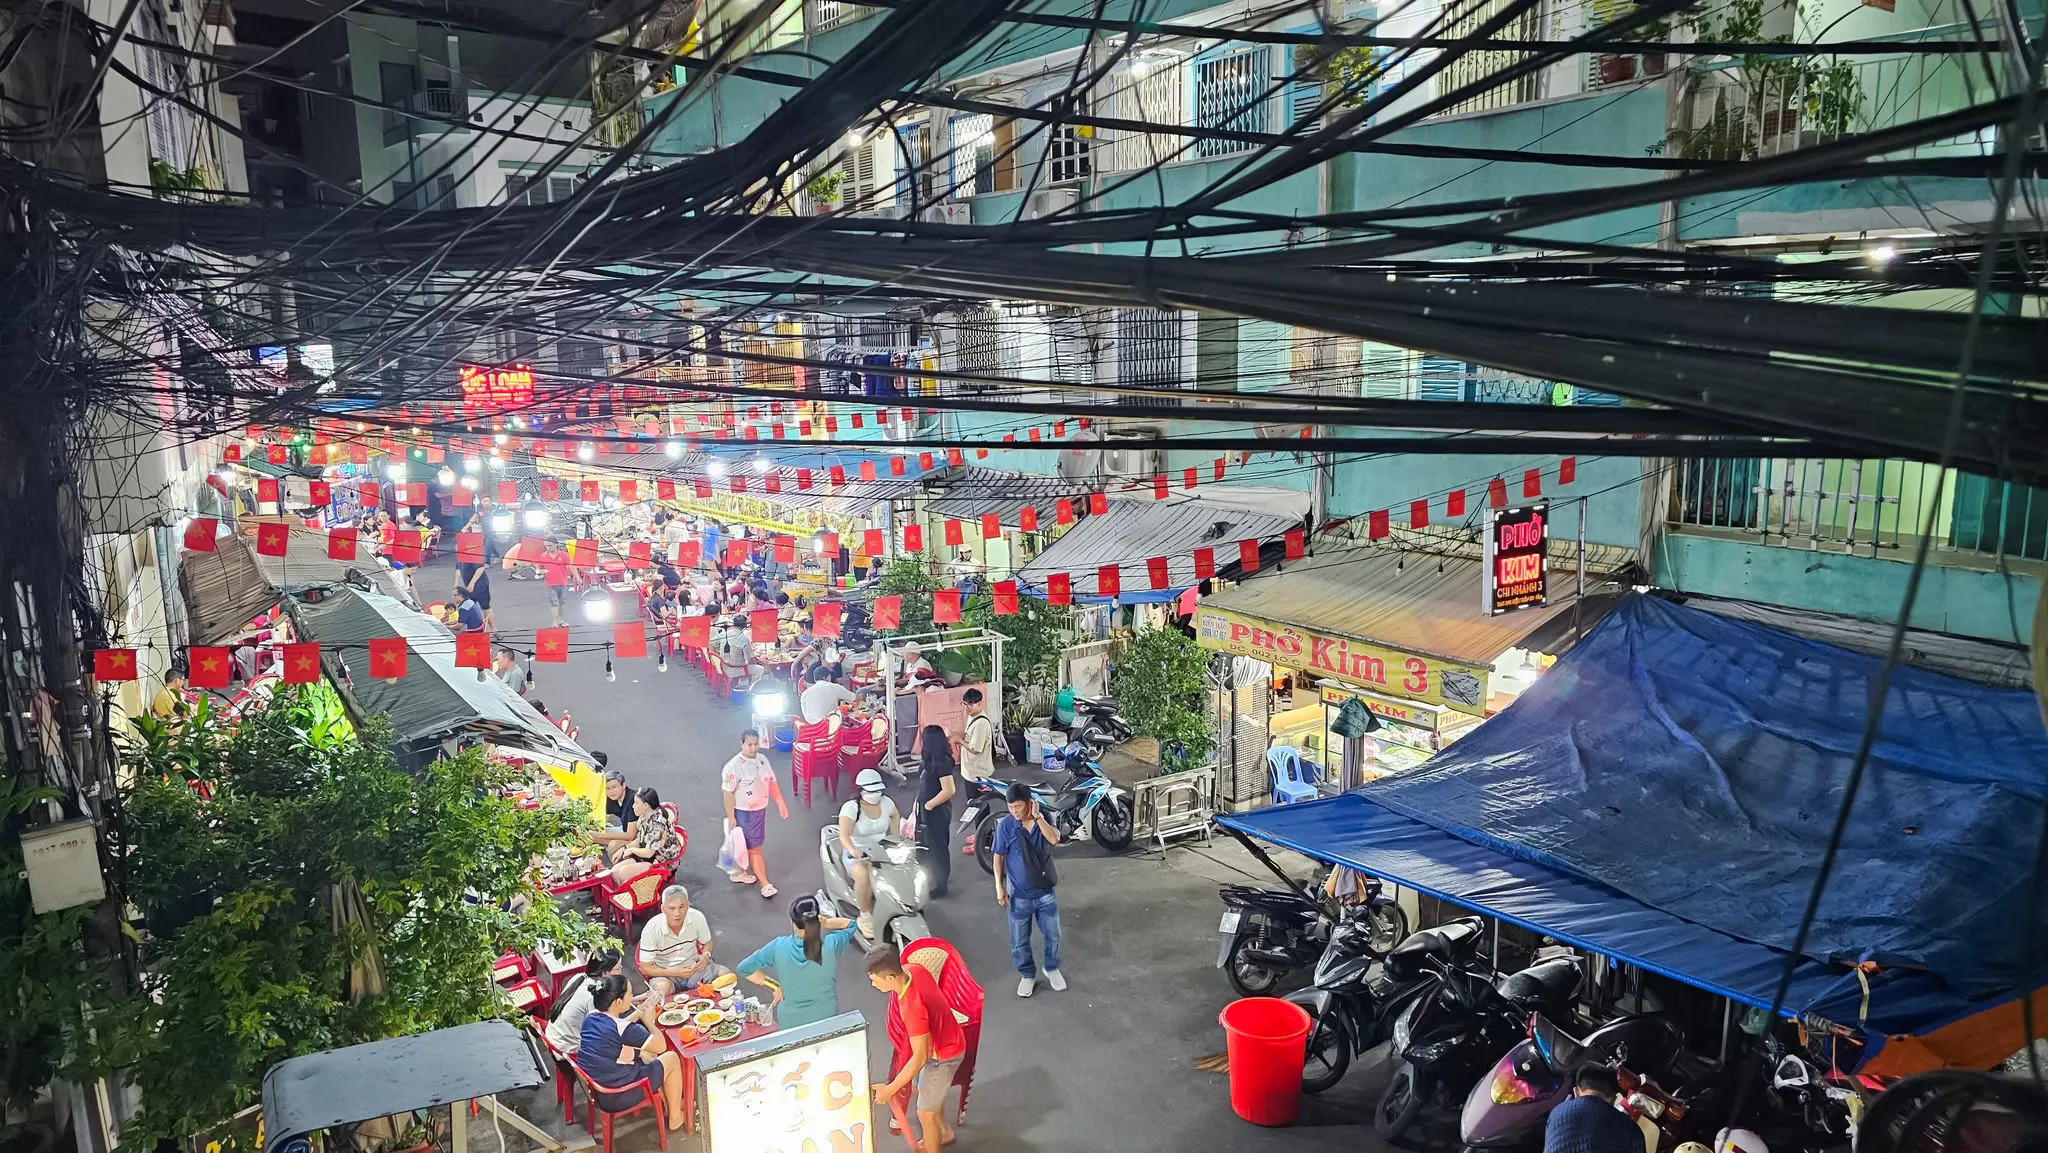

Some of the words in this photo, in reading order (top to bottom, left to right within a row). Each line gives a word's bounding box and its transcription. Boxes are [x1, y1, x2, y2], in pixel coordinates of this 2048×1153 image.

[1501, 512, 1543, 550] PHỞ
[1501, 553, 1541, 585] KIM
[1496, 587, 1511, 599] CHI
[1511, 581, 1537, 596] NHÁNH
[1537, 580, 1543, 591] 3
[1230, 622, 1303, 656] PHỞ
[1309, 635, 1388, 686] Kim
[1403, 656, 1430, 695] 3
[1369, 702, 1408, 719] KIM
